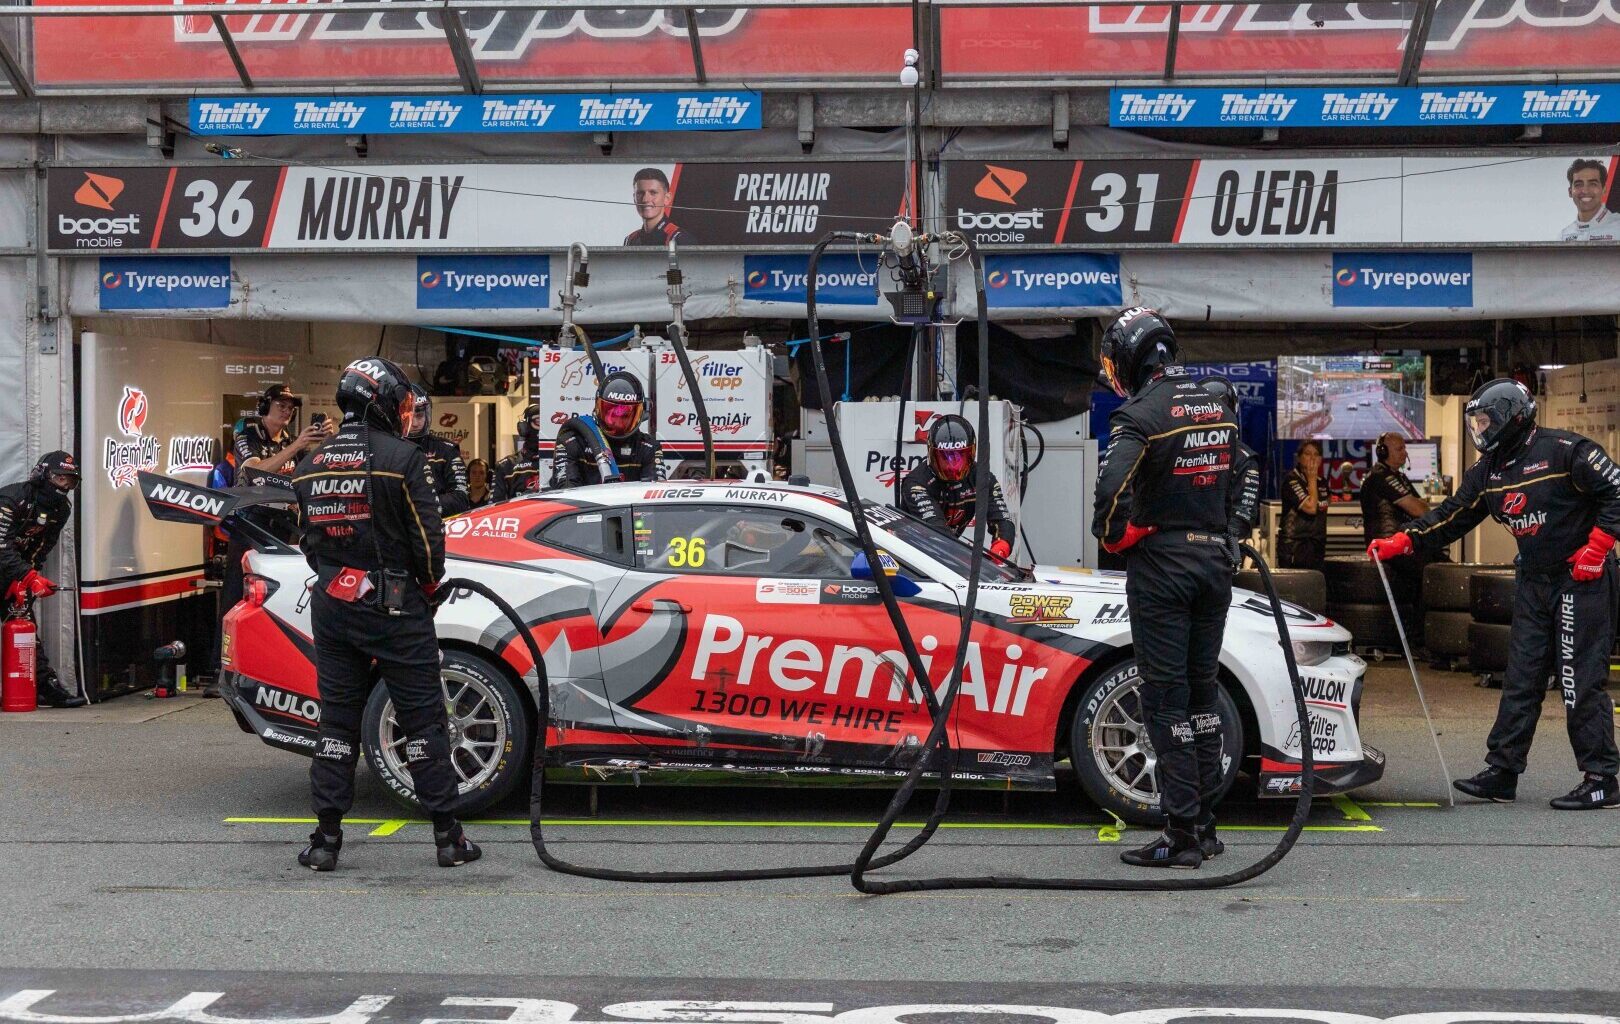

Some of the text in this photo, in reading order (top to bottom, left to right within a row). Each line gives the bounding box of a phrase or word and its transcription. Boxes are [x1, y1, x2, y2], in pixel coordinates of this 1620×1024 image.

[199, 102, 270, 129] Thrifty
[294, 102, 366, 128] Thrifty
[389, 101, 462, 127] Thrifty
[482, 100, 555, 127] Thrifty
[579, 99, 652, 126] Thrifty
[677, 98, 751, 125] Thrifty
[1120, 94, 1196, 121] Thrifty
[1220, 94, 1297, 121] Thrifty
[1321, 93, 1398, 120] Thrifty
[1420, 91, 1498, 119] Thrifty
[1522, 89, 1600, 117] Thrifty
[735, 173, 830, 201] PREMIAIR
[180, 179, 254, 238] 36
[297, 175, 464, 241] MURRAY
[1085, 172, 1159, 233] 31
[1210, 169, 1339, 237] OJEDA
[59, 214, 140, 235] boost
[746, 205, 819, 233] RACING
[958, 207, 1043, 230] boost
[76, 237, 122, 248] mobile
[976, 232, 1025, 243] mobile
[125, 271, 230, 293] Tyrepower
[443, 270, 548, 291] Tyrepower
[1012, 269, 1118, 290] Tyrepower
[1360, 268, 1471, 289] Tyrepower
[1118, 306, 1151, 327] NUL
[349, 359, 386, 380] LON
[544, 353, 561, 362] 36
[661, 353, 677, 363] 31
[608, 391, 637, 401] NULON
[710, 377, 742, 390] app
[170, 437, 214, 467] NULON
[938, 440, 967, 449] NULON
[1184, 430, 1230, 448] NULON
[105, 436, 161, 469] PremiAir
[150, 483, 224, 515] NULON
[311, 479, 365, 495] NULON
[725, 490, 789, 502] MURRAY
[475, 517, 520, 531] AIR
[482, 531, 517, 539] ALLIED
[668, 537, 706, 567] 36
[842, 583, 881, 594] boost
[842, 592, 868, 600] mobile
[1010, 594, 1073, 606] POWER
[1012, 606, 1068, 618] CRANK
[1561, 594, 1576, 709] 1300 WE HIRE
[690, 613, 1048, 717] PremiAir
[255, 686, 321, 720] NULO
[1087, 665, 1139, 715] DUNLO
[1299, 677, 1346, 703] NULON
[691, 689, 905, 733] 1300 WE HIRE
[992, 752, 1031, 765] Repco
[1312, 736, 1336, 755] app
